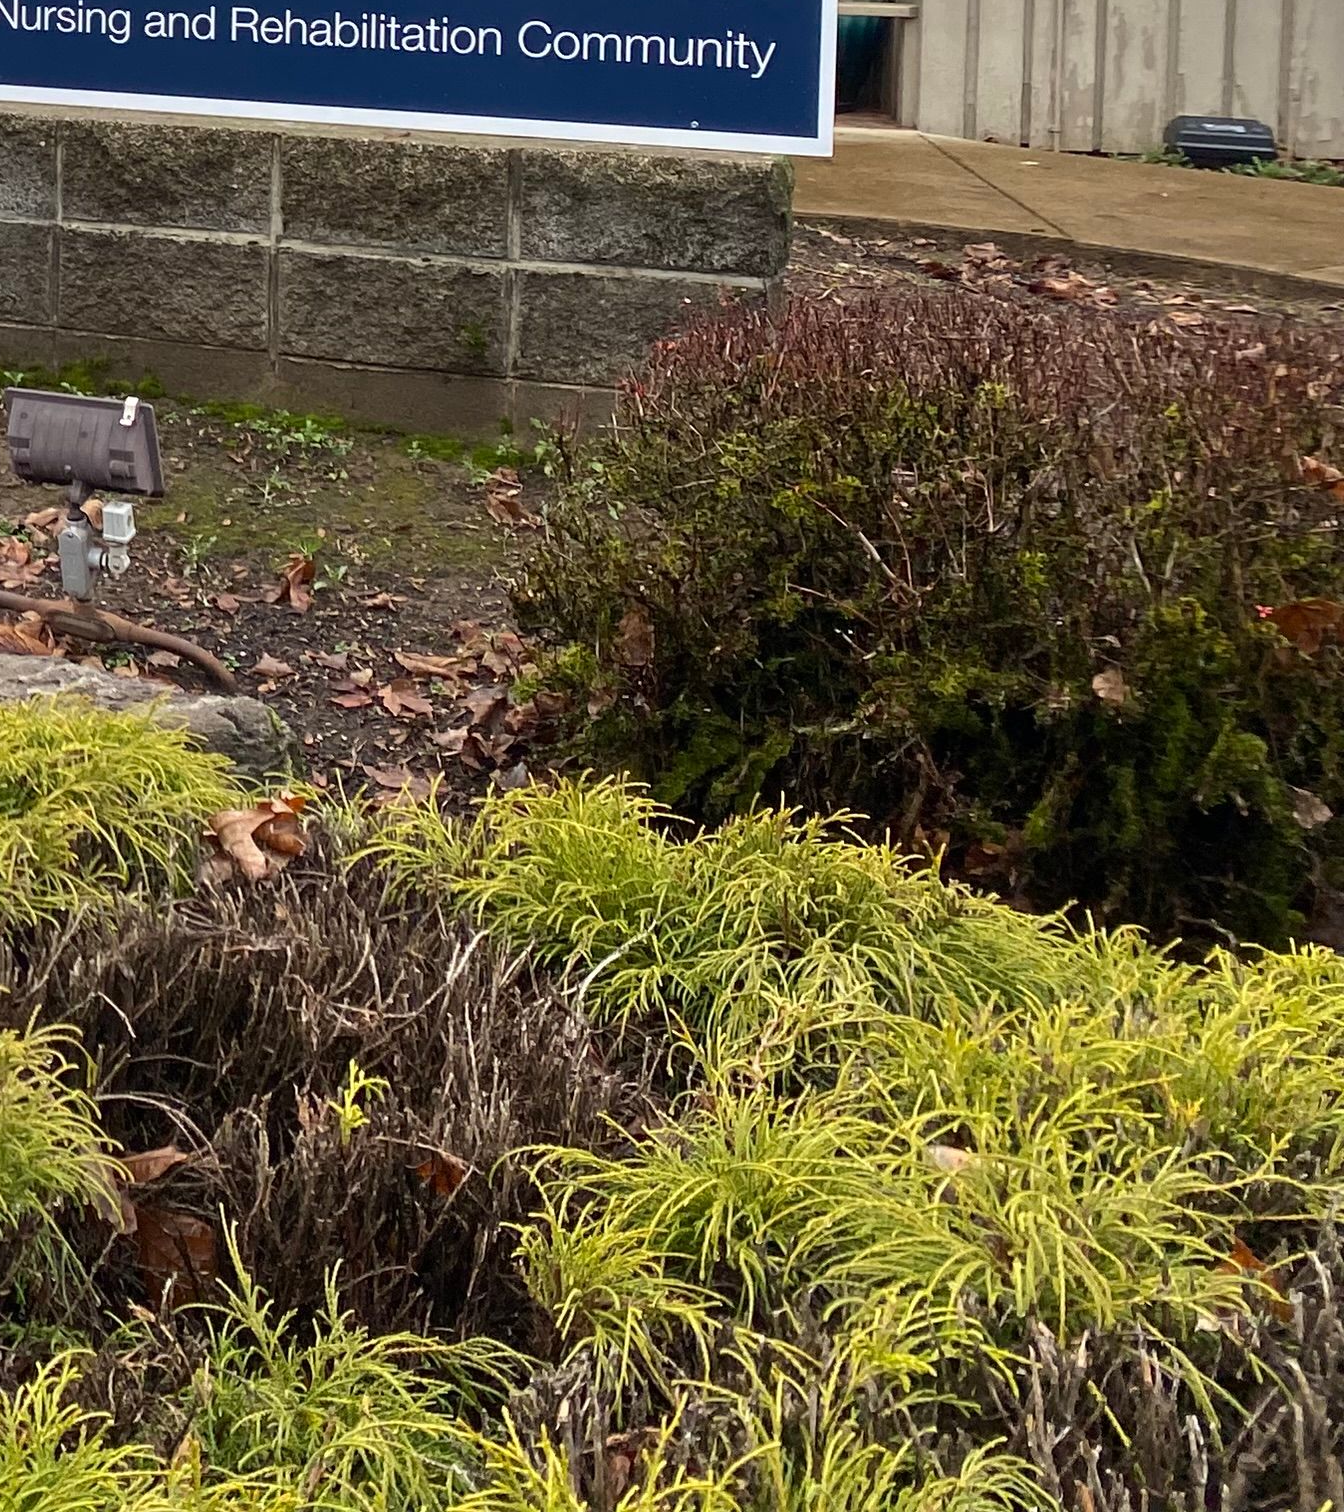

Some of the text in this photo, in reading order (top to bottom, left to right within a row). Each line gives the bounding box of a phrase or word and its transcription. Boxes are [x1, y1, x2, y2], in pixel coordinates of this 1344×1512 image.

[144, 5, 216, 41] and
[231, 6, 502, 56] Rehabilitation
[517, 20, 777, 79] Community
